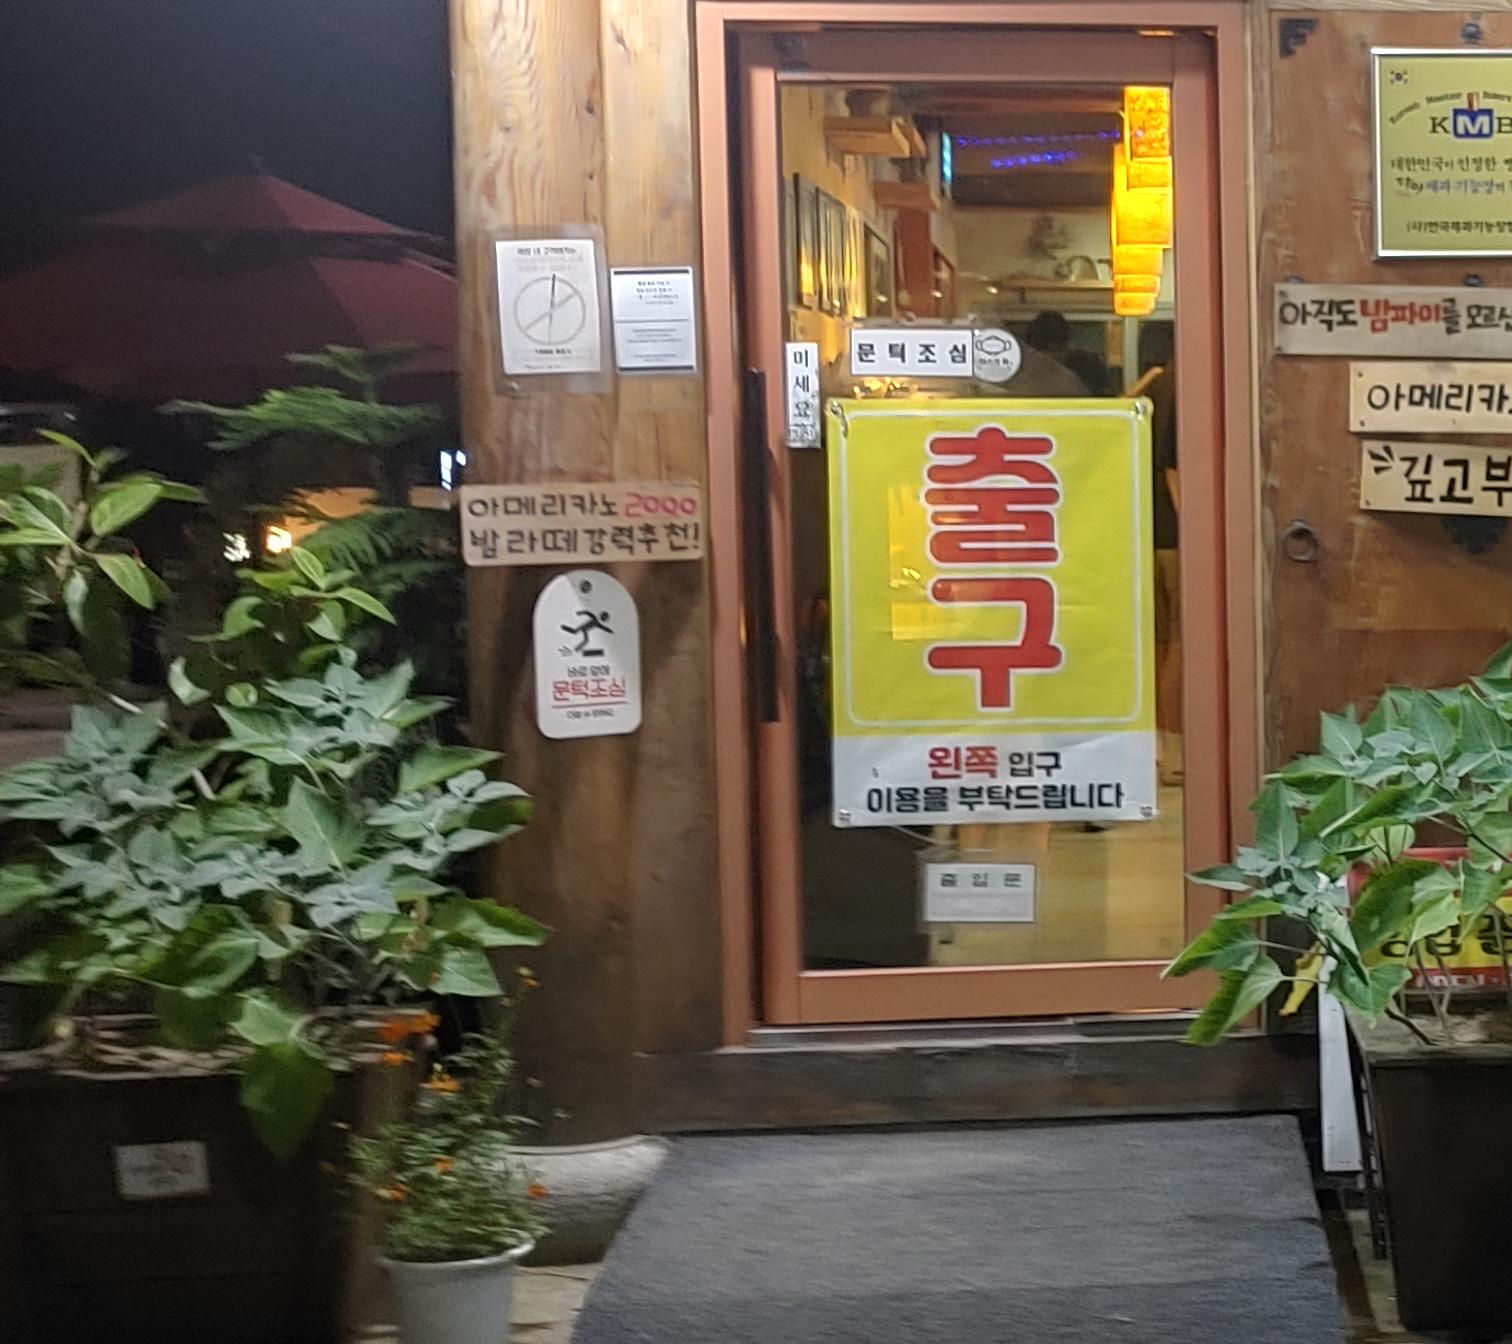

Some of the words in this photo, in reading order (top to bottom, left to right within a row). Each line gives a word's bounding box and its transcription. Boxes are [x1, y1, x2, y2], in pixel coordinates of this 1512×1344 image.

[1279, 299, 1358, 332] 아직도
[857, 342, 968, 364] 문턱조심
[792, 348, 812, 419] 미세요
[468, 491, 618, 517] 아메리카노
[624, 492, 697, 518] 2000
[924, 426, 1063, 709] 출구
[928, 745, 998, 780] 왼쪽
[1008, 750, 1063, 778] 입구
[866, 786, 950, 813] 이용을
[957, 782, 1125, 812] 부탁드립니다
